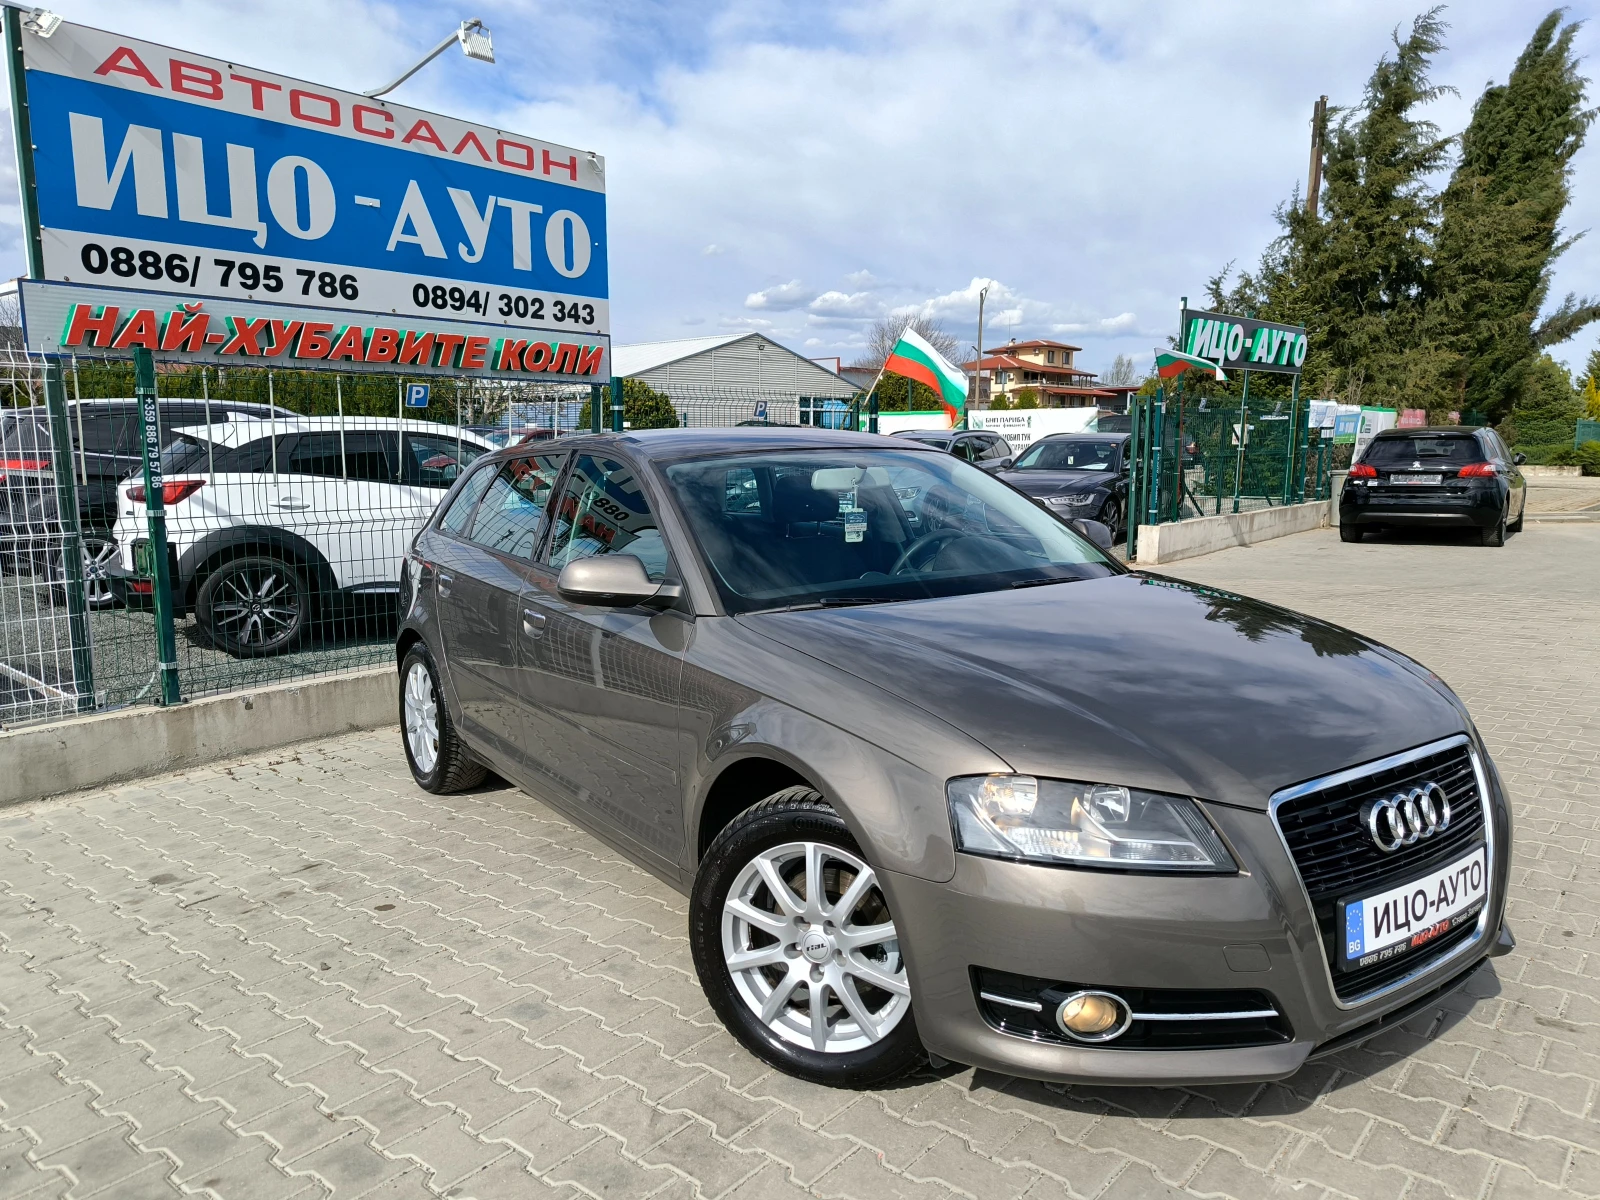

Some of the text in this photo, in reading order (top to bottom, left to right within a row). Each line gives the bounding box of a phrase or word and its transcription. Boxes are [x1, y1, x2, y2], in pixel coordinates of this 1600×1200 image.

[94, 46, 578, 182] АВТОСАЛОН
[80, 243, 359, 301] 0886/ 795 786
[412, 283, 595, 326] 0894/ 302 343
[64, 301, 604, 376] НАЙ-ХУБАВИТЕ КОЛИ
[1191, 318, 1308, 368] ИЦО-АУТО
[410, 386, 425, 405] P
[144, 397, 162, 488] +359 886 79 57 86
[1373, 859, 1482, 939] ИЦО-АУТО
[1348, 939, 1361, 954] BG
